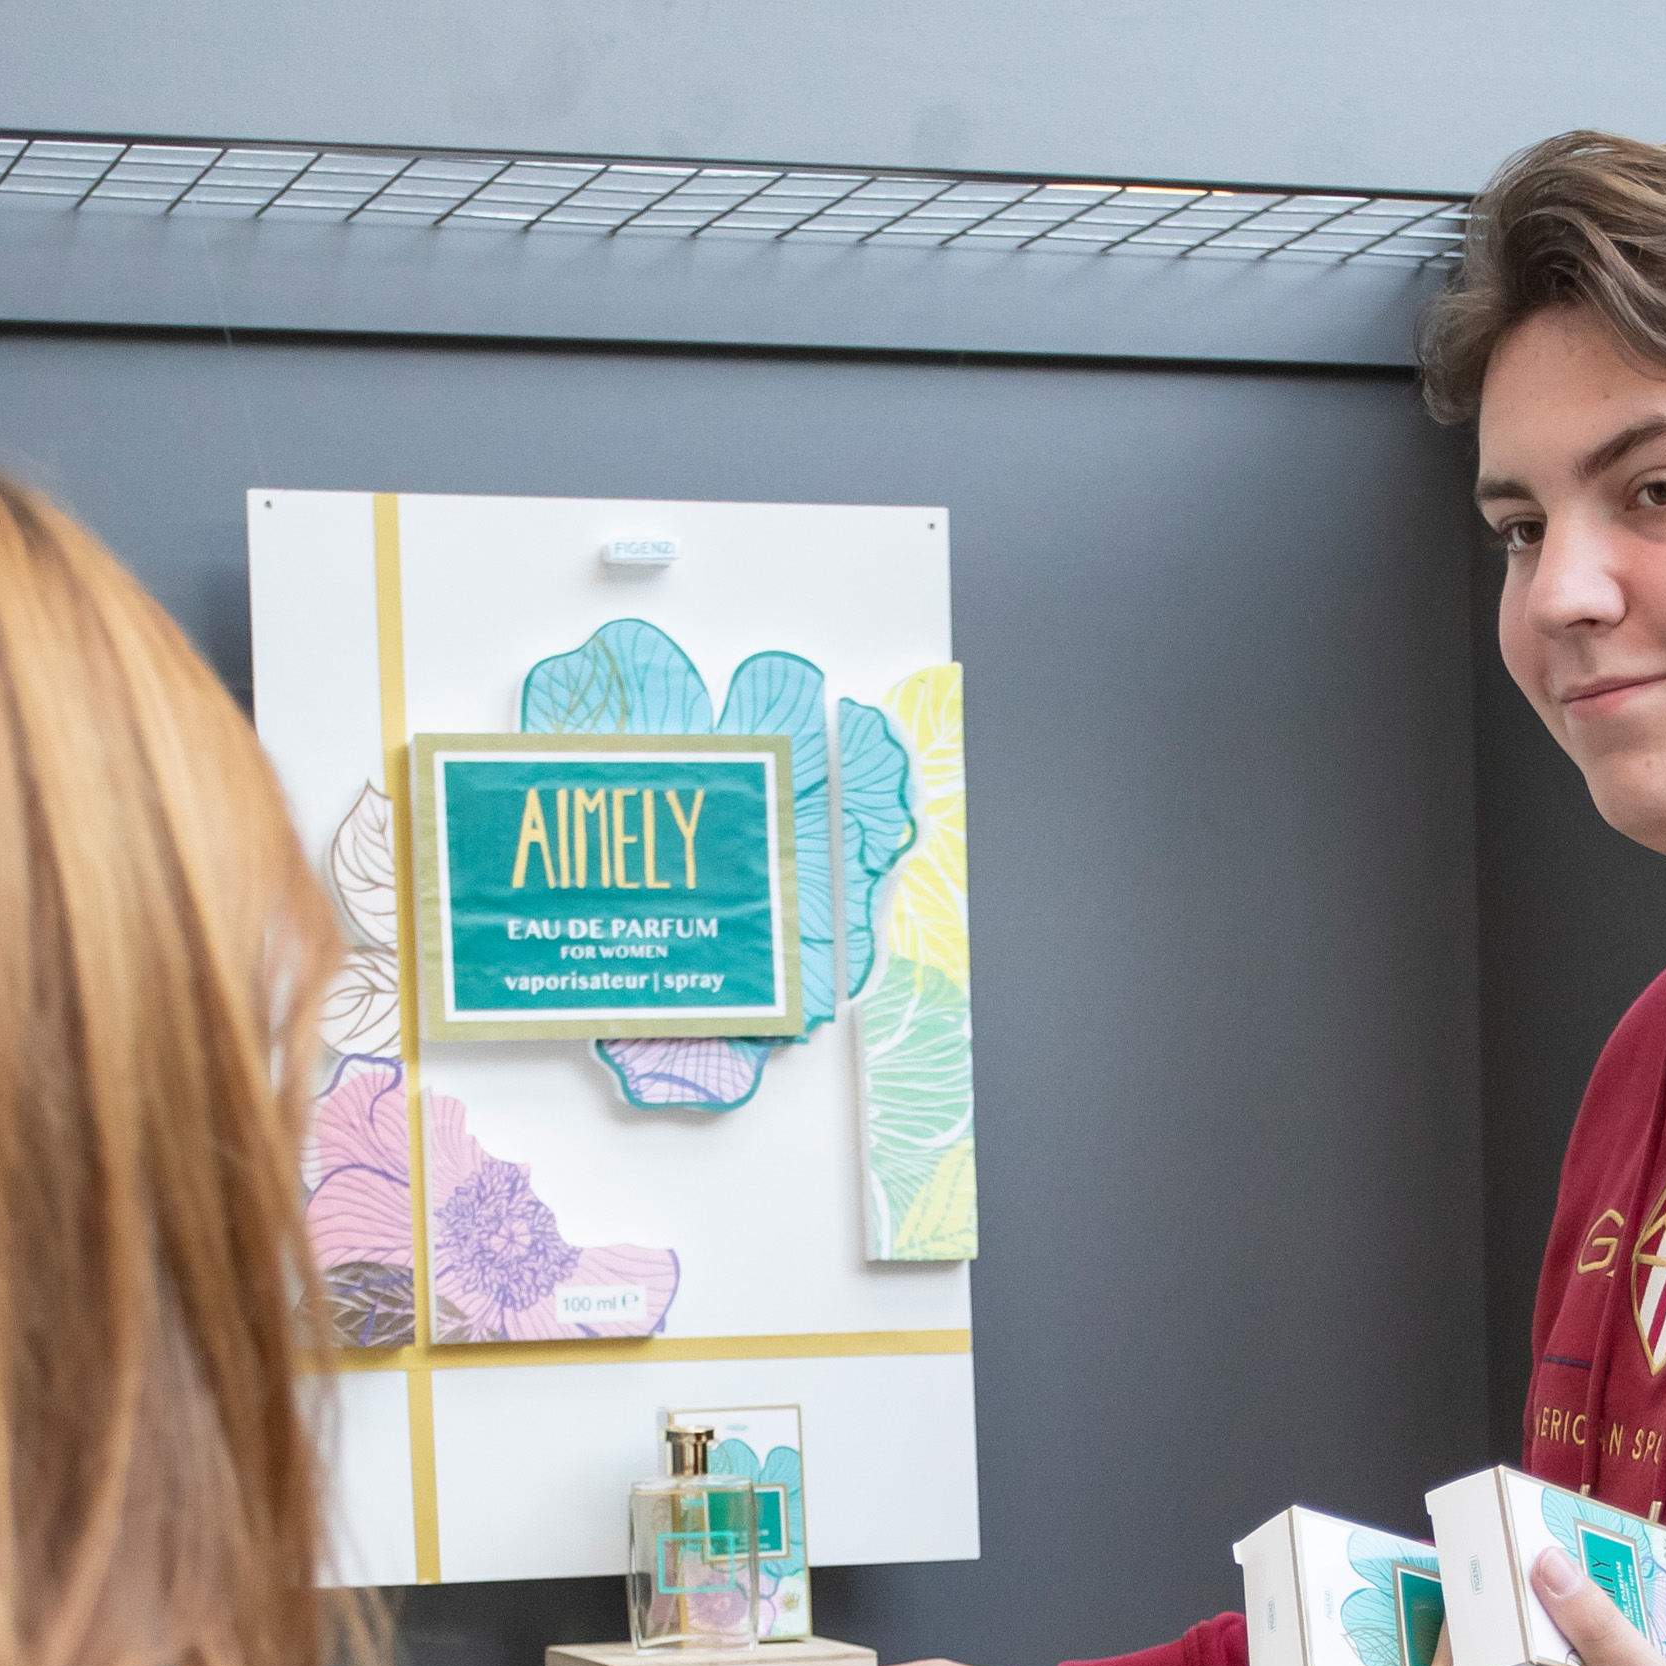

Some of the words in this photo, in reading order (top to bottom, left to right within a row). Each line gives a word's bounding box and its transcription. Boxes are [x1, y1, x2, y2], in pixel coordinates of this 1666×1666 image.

[511, 787, 705, 889] AIMELY
[506, 918, 562, 940] EAU
[567, 918, 604, 940] DE
[610, 917, 719, 939] PARFUM
[559, 944, 597, 960] FOR
[599, 944, 669, 959] WOMEN
[504, 969, 650, 995] vaporisateur
[663, 972, 726, 994] spray
[563, 1296, 592, 1313] 100
[596, 1295, 617, 1312] ml
[1472, 1559, 1482, 1592] FIGENZI
[1615, 1560, 1628, 1603] PARFUM
